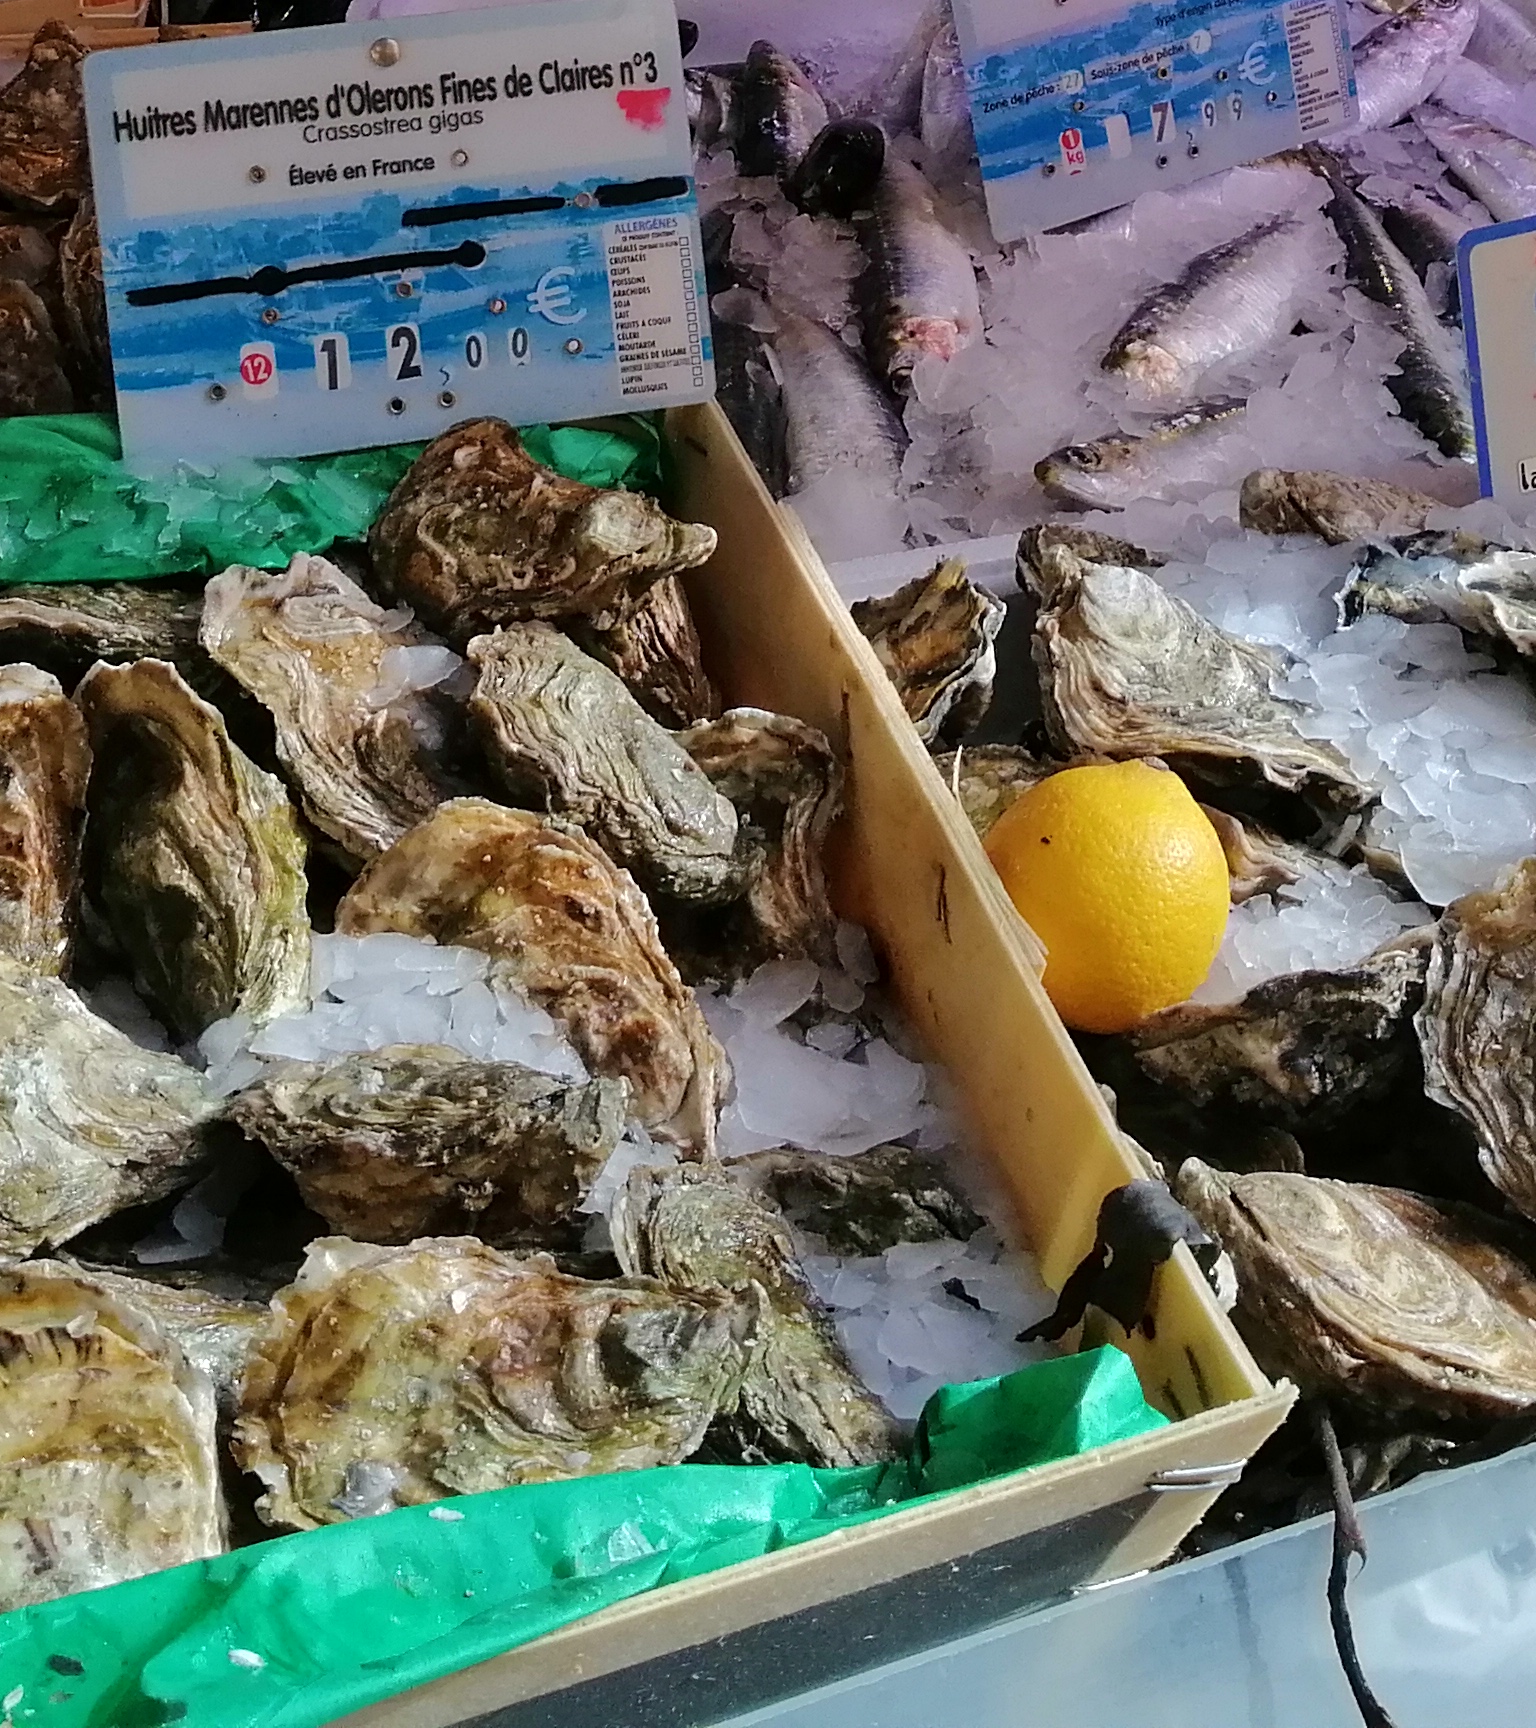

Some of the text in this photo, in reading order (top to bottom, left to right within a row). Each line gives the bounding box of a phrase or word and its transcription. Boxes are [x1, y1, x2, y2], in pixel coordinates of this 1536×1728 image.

[1143, 52, 1155, 65] de
[114, 50, 659, 144] Huitres Marennes d'Olerons Fines de Claires n°3
[983, 100, 1010, 114] Zone
[1011, 94, 1023, 107] de
[302, 107, 484, 146] Crassostrea gigas
[288, 155, 436, 188] Élevé en France
[243, 356, 272, 383] 12
